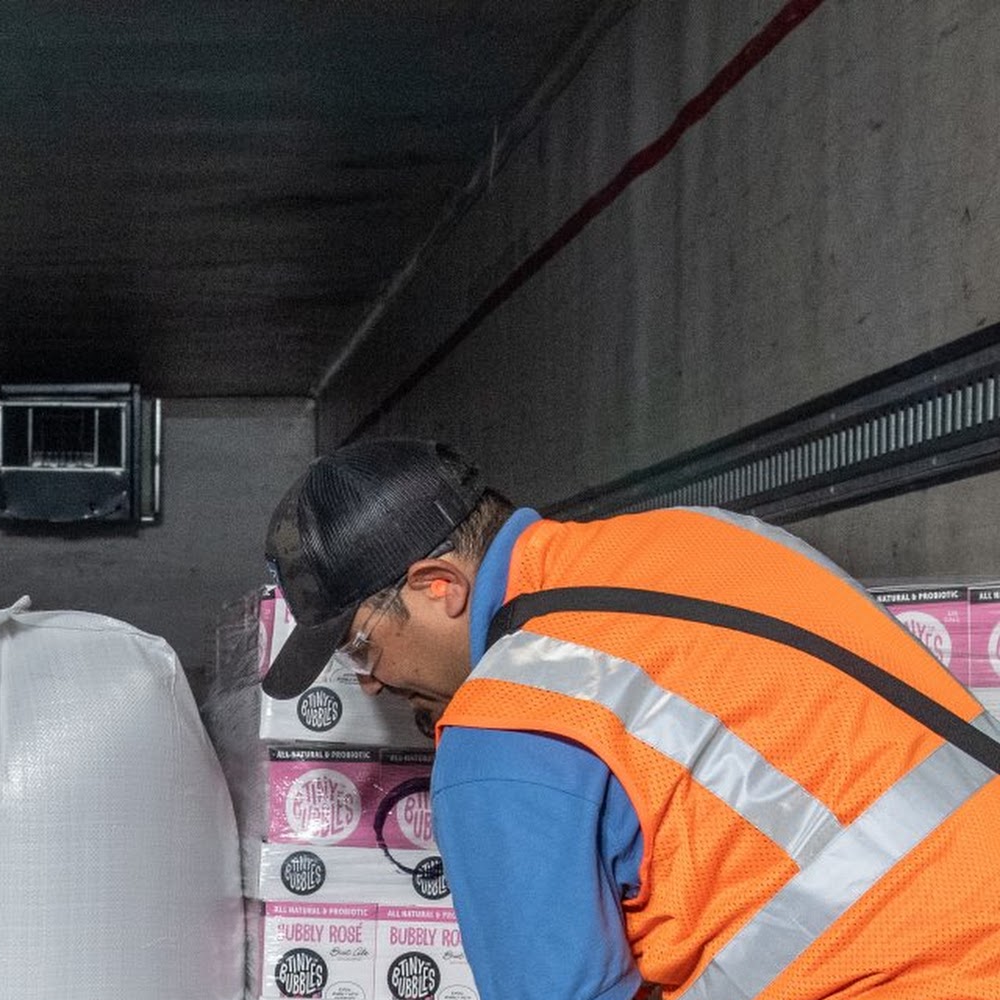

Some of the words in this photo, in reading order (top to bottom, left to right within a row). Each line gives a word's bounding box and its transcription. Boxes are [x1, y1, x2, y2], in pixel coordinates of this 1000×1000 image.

[918, 590, 959, 600] PROBIOTIC
[979, 592, 992, 600] ALL
[307, 691, 333, 708] TINY
[301, 700, 338, 728] BUBBLES
[291, 856, 316, 872] TINY
[286, 864, 321, 891] BUBBLES
[388, 911, 401, 919] ALL
[402, 912, 434, 920] NATURAL
[277, 923, 324, 943] BUBBLY
[329, 922, 363, 944] ROSÉ
[390, 927, 434, 946] BUBBLY
[442, 928, 461, 947] RO
[286, 953, 312, 972] TINY
[398, 955, 425, 977] TINY
[279, 963, 323, 994] BUBBLES
[392, 965, 436, 999] BUBBLES
